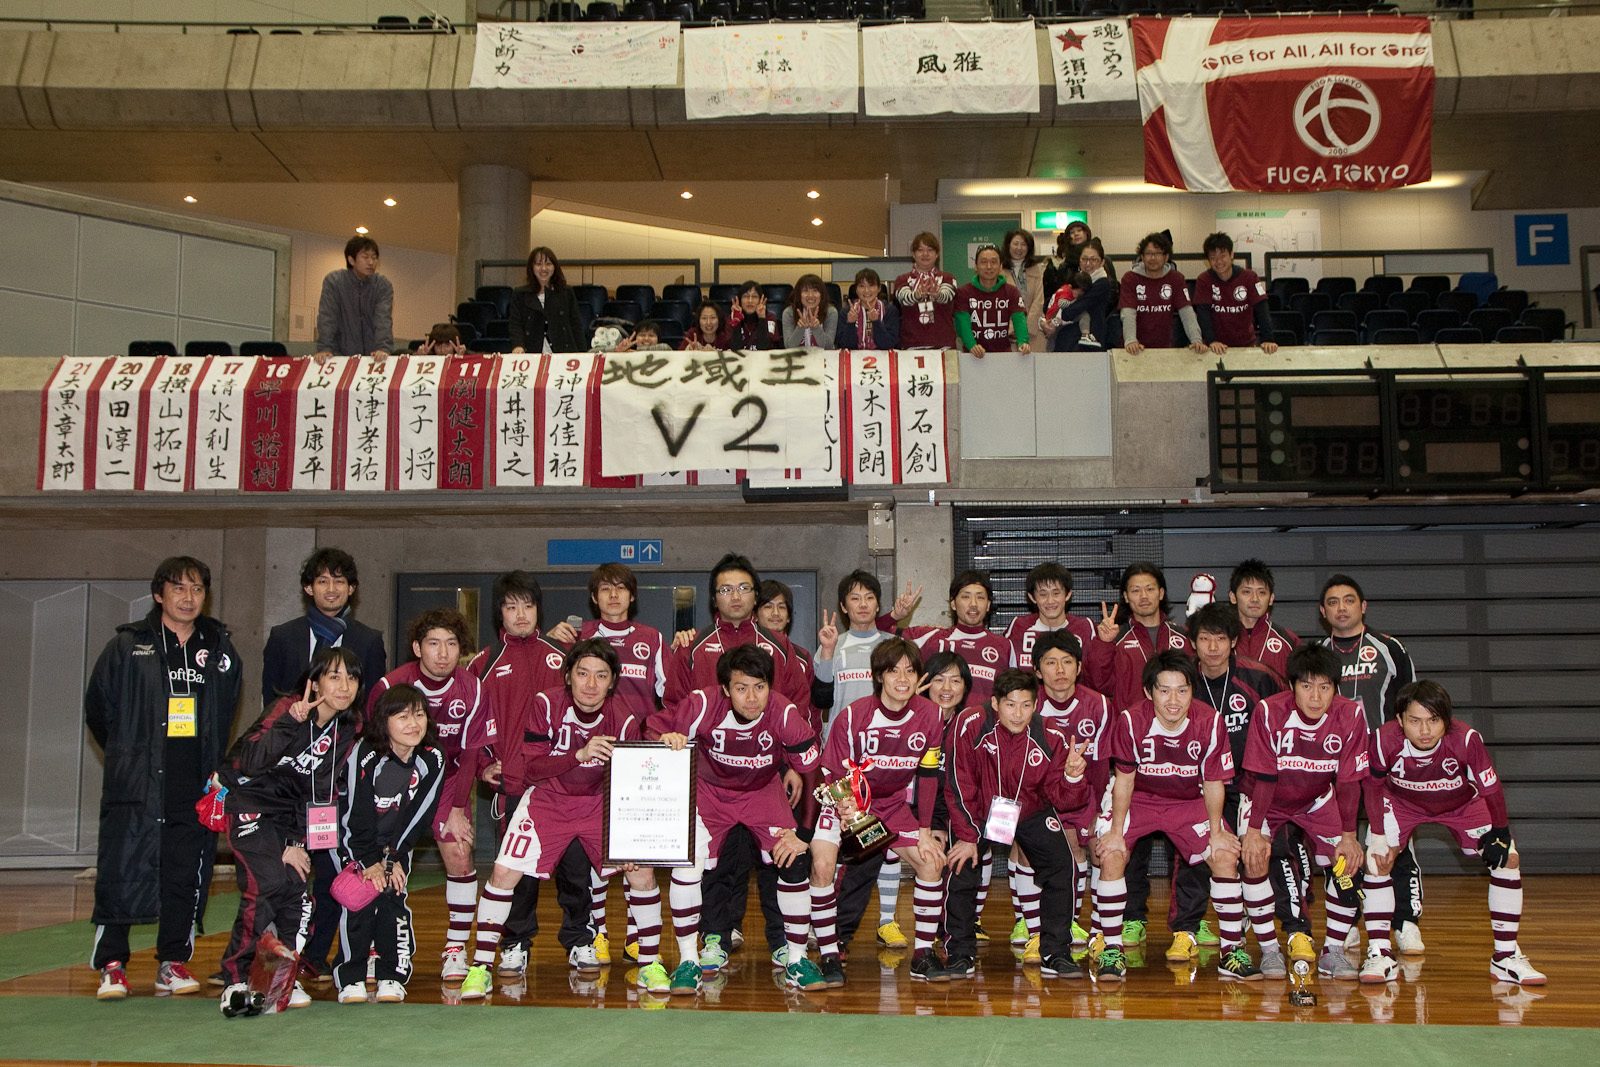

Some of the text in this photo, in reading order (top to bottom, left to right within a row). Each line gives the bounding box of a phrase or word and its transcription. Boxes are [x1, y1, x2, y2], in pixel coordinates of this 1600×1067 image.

[495, 27, 523, 77] 決断力
[1093, 22, 1124, 80] 魂こめろ
[1249, 49, 1276, 63] for
[1319, 43, 1343, 57] All
[1350, 43, 1377, 57] for
[756, 58, 793, 74] 東京
[1062, 57, 1088, 100] 須賀
[1310, 76, 1362, 91] FUGA TOKYO
[1267, 163, 1409, 184] FUGA TOKYO
[1528, 223, 1555, 257] F
[969, 297, 1009, 309] One for
[970, 310, 1009, 328] ALL
[972, 330, 981, 339] or
[70, 362, 92, 375] 21
[118, 362, 143, 375] 20
[171, 363, 193, 375] 18
[222, 362, 244, 375] 17
[265, 363, 291, 378] 16
[366, 362, 387, 375] 14
[416, 362, 436, 374] 12
[459, 362, 482, 377] 11
[511, 359, 531, 372] 10
[565, 358, 581, 372] 9
[601, 350, 820, 393] 地域王
[862, 355, 878, 369] 2
[913, 355, 925, 369] 1
[52, 376, 81, 482] 大黒章太郎
[104, 377, 134, 476] 内田淳二
[153, 376, 190, 483] 横山拓也
[205, 378, 238, 480] 清水利生
[299, 376, 331, 485] 山上康平
[651, 393, 780, 458] V2
[906, 374, 938, 475] 揚石創
[169, 668, 205, 684] oftBa
[1224, 712, 1247, 727] LTY
[858, 729, 880, 754] 16
[1141, 737, 1156, 763] 3
[1276, 728, 1295, 755] 14
[1140, 765, 1198, 776] HottoMott
[1390, 756, 1406, 779] 4
[503, 831, 532, 859] 10
[1280, 859, 1300, 903] PENALTY
